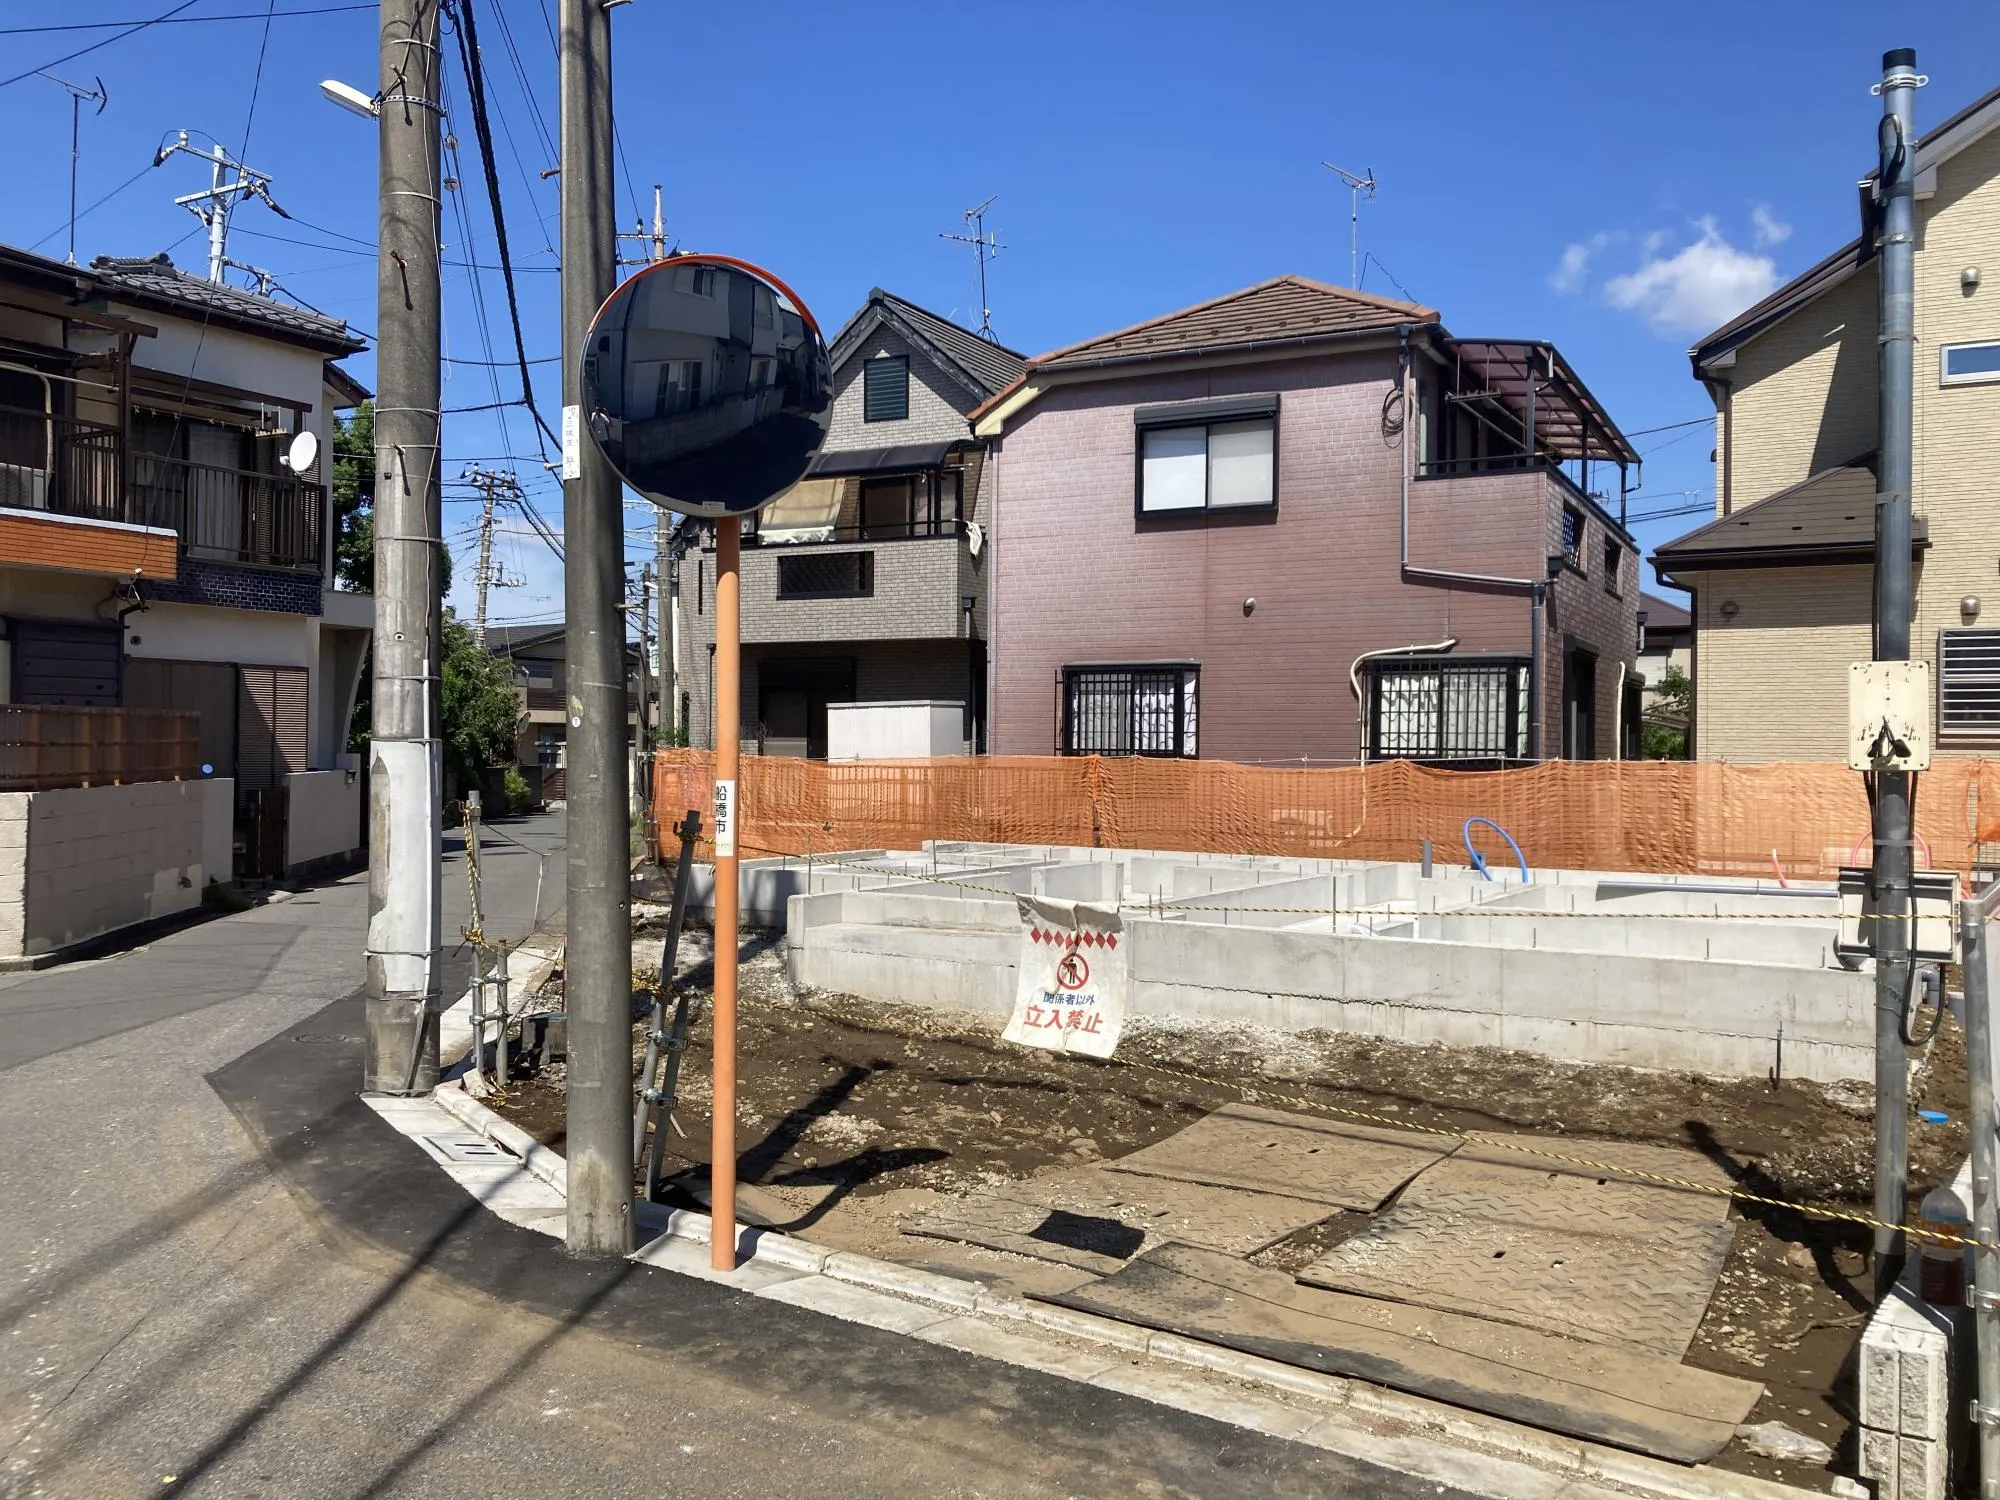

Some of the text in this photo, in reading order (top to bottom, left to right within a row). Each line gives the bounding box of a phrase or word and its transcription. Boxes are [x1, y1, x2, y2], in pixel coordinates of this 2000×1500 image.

[716, 785, 727, 834] 船橋市
[1043, 991, 1096, 1006] 関係者以外
[1024, 1005, 1104, 1034] 立入禁止
